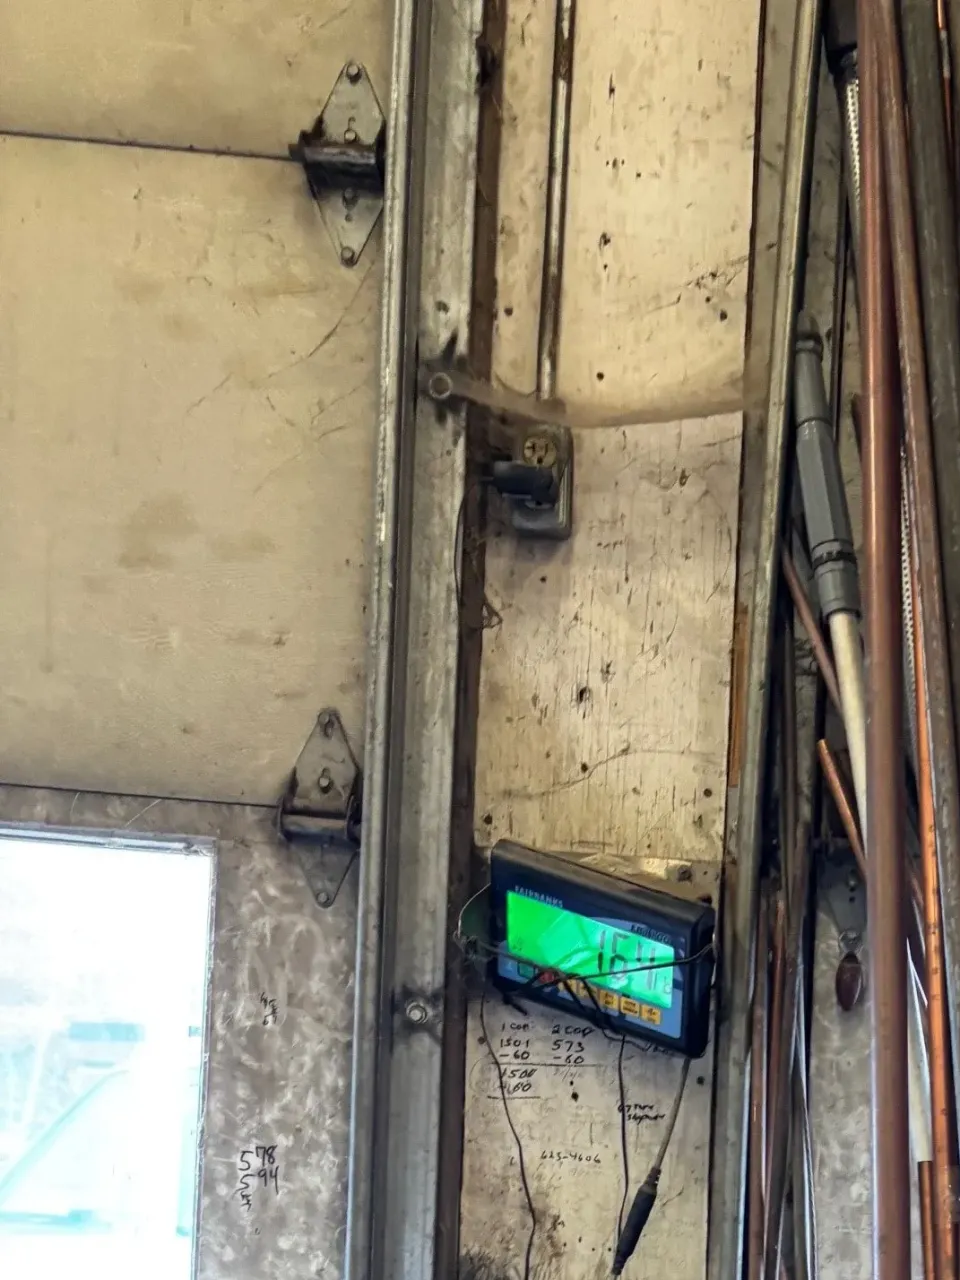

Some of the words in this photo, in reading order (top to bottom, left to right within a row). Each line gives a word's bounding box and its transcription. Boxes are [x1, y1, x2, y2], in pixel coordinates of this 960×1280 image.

[551, 1039, 585, 1053] 573
[237, 1144, 278, 1172] 578
[233, 1165, 280, 1197] 594
